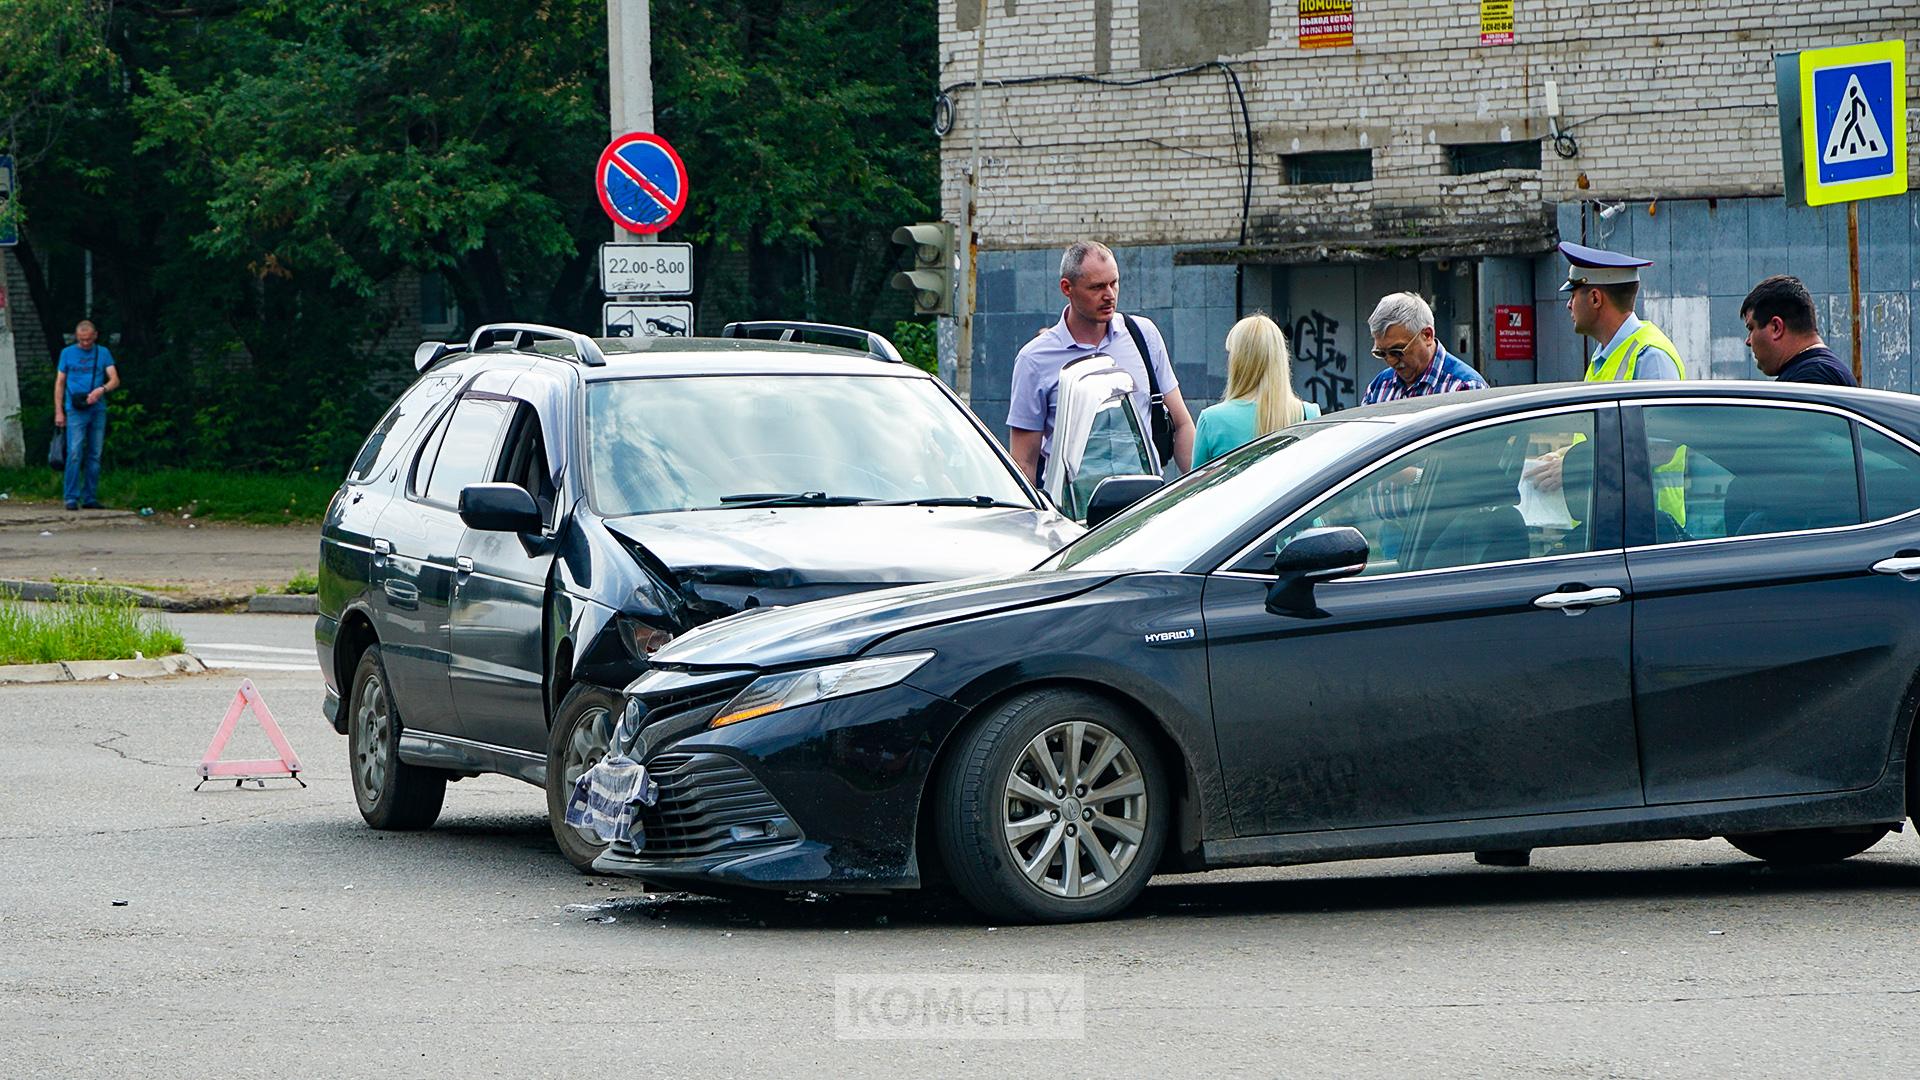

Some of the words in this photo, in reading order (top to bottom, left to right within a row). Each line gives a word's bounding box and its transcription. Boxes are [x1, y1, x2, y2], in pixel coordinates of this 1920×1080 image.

[1300, 0, 1352, 11] ПОМОЩЬ
[1300, 16, 1329, 26] ВЫХОД
[609, 258, 685, 274] 22.00-8.00
[1144, 630, 1188, 643] HYBRID
